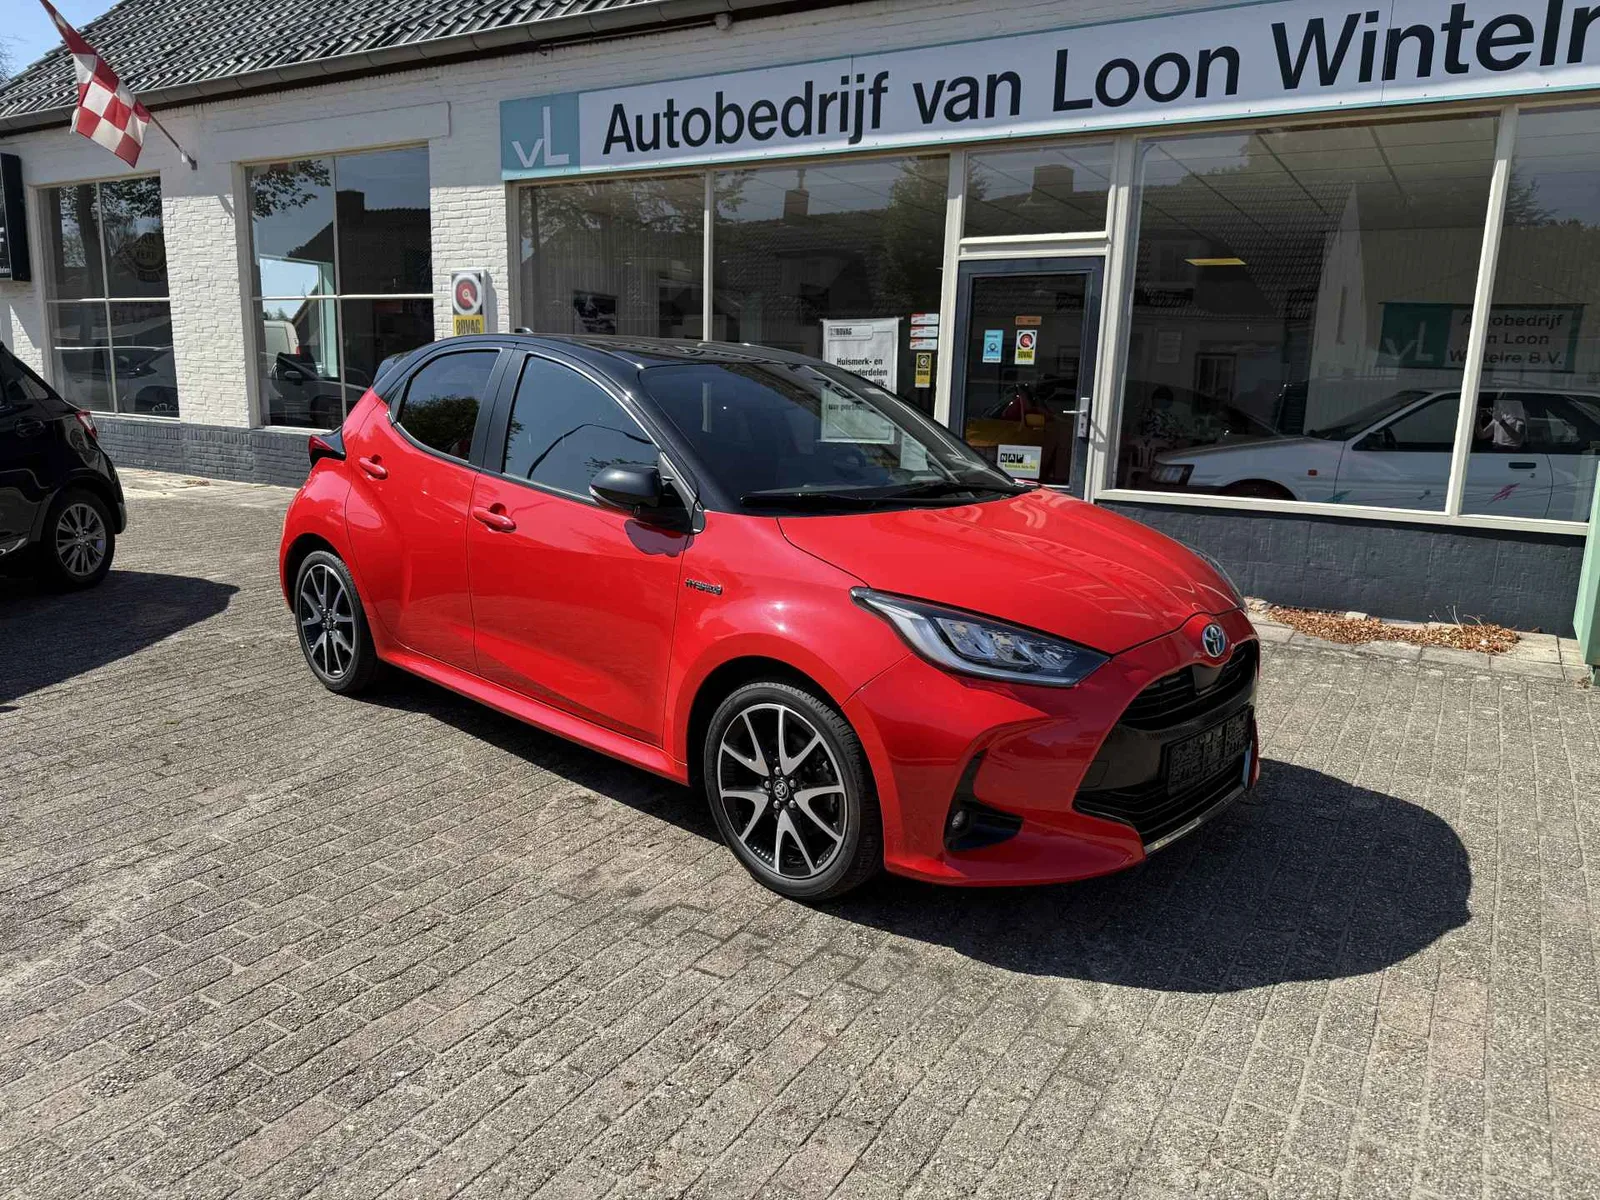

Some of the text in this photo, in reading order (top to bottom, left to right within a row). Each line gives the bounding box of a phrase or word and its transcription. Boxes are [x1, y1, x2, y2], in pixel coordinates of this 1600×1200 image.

[602, 71, 889, 145] Autobedrijf
[913, 70, 1022, 124] van
[1053, 46, 1241, 111] Loon
[511, 106, 570, 168] vL
[456, 319, 481, 335] BOVAG
[1461, 313, 1564, 330] Aobedrijf
[1504, 333, 1550, 345] Loon
[837, 357, 872, 366] Huismerk-
[1449, 350, 1522, 365] Wtelre
